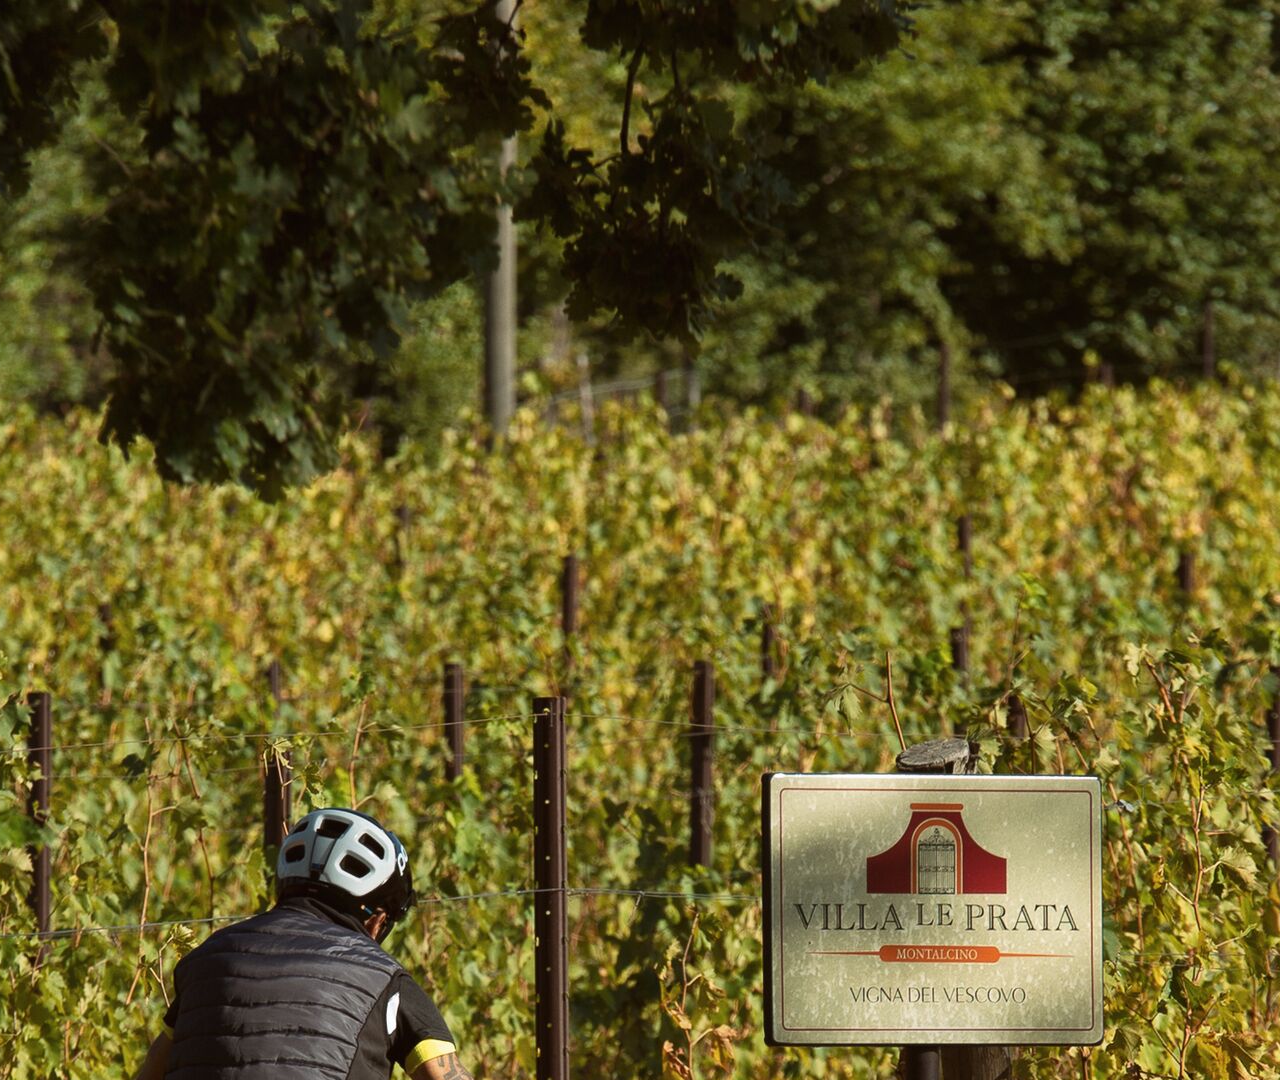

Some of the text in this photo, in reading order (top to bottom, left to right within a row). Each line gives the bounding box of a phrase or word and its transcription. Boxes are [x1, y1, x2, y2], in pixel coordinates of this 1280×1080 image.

[792, 902, 1080, 932] VILLA LE PRATA
[895, 947, 979, 961] MONTALCINO
[849, 986, 1027, 1005] VIGNA DEL VESCOVO
